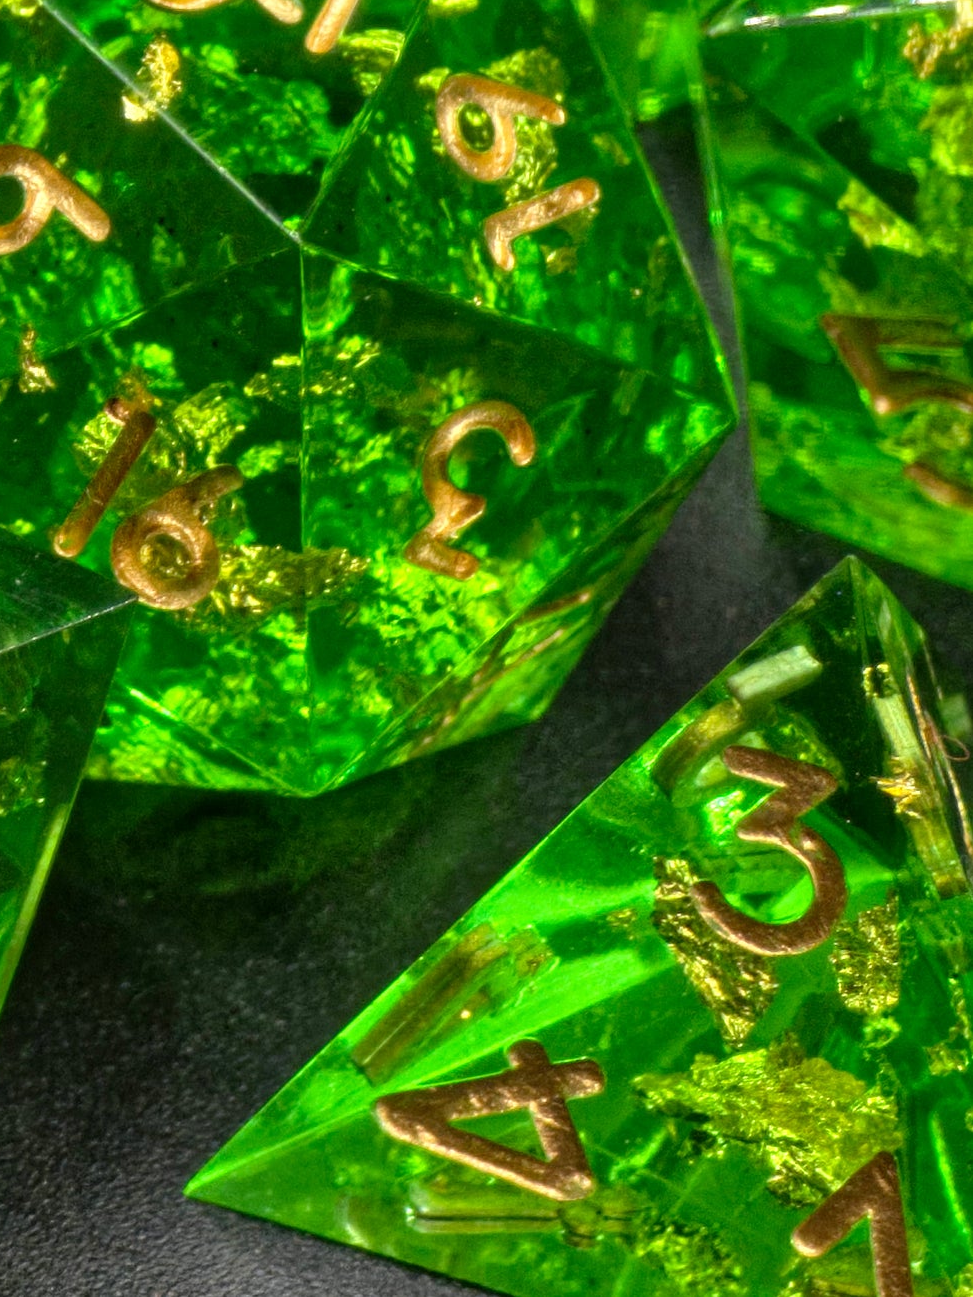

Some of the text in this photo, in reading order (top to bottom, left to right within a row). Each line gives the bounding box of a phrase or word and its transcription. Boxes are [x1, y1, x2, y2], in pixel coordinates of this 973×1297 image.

[405, 401, 535, 580] 3
[690, 745, 848, 956] 3
[375, 1037, 605, 1200] 4
